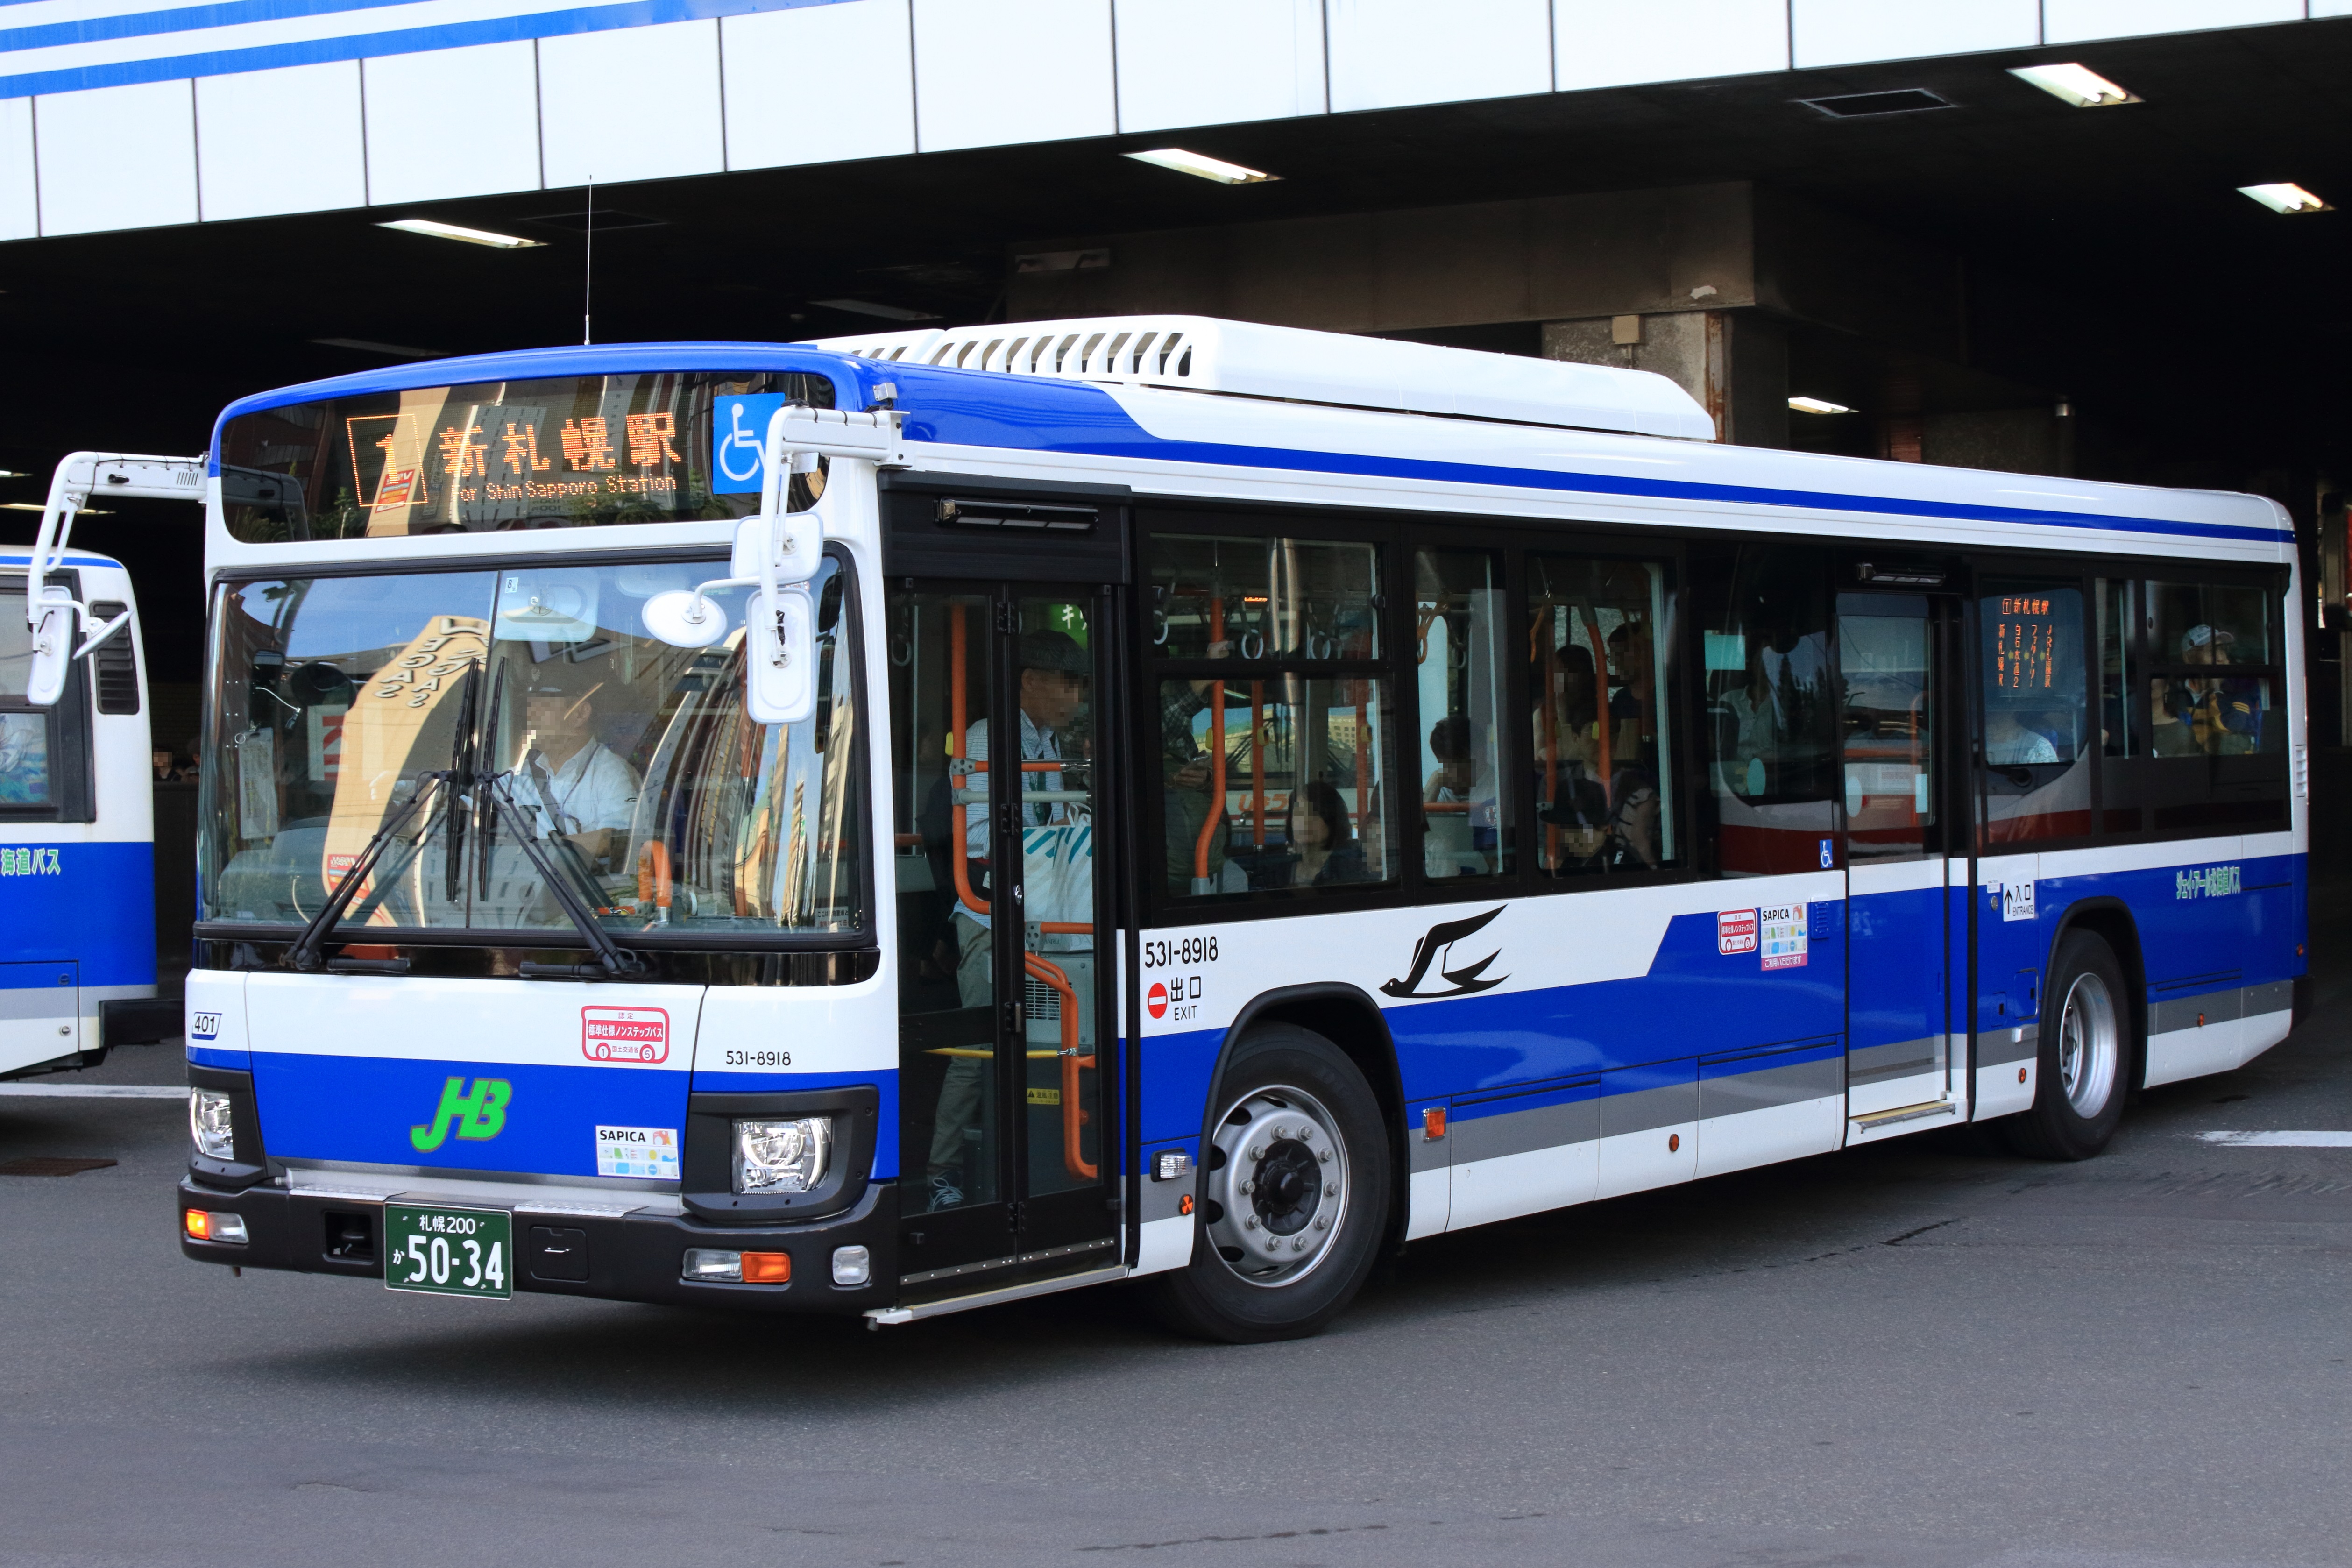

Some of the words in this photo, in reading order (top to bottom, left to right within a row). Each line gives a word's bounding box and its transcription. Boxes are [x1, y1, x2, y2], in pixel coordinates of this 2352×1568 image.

[375, 434, 399, 484] 1
[438, 412, 681, 477] 新札幌駅
[486, 482, 522, 500] Shin
[526, 480, 598, 498] Sapporo
[606, 474, 676, 493] Station
[2014, 598, 2049, 615] 新札幌駅
[1, 847, 61, 877] 海道バス
[2015, 884, 2031, 903] 入口
[1763, 909, 1789, 921] SAPICA
[2013, 905, 2033, 916] ENTRANCE
[1145, 936, 1219, 968] 531-8918
[1764, 955, 1802, 968] ご利用いただけます
[1170, 976, 1201, 1002] 出口
[1174, 1005, 1197, 1021] EXIT
[194, 1015, 215, 1033] 401
[588, 1024, 663, 1038] 標準仕様ノンステップバス
[601, 1048, 605, 1057] 1
[645, 1050, 651, 1059] 5
[726, 1051, 791, 1066] 531-8918
[600, 1130, 646, 1142] SAPICA
[419, 1216, 475, 1235] 札幌200
[392, 1249, 405, 1265] か
[408, 1235, 504, 1289] 50-34
